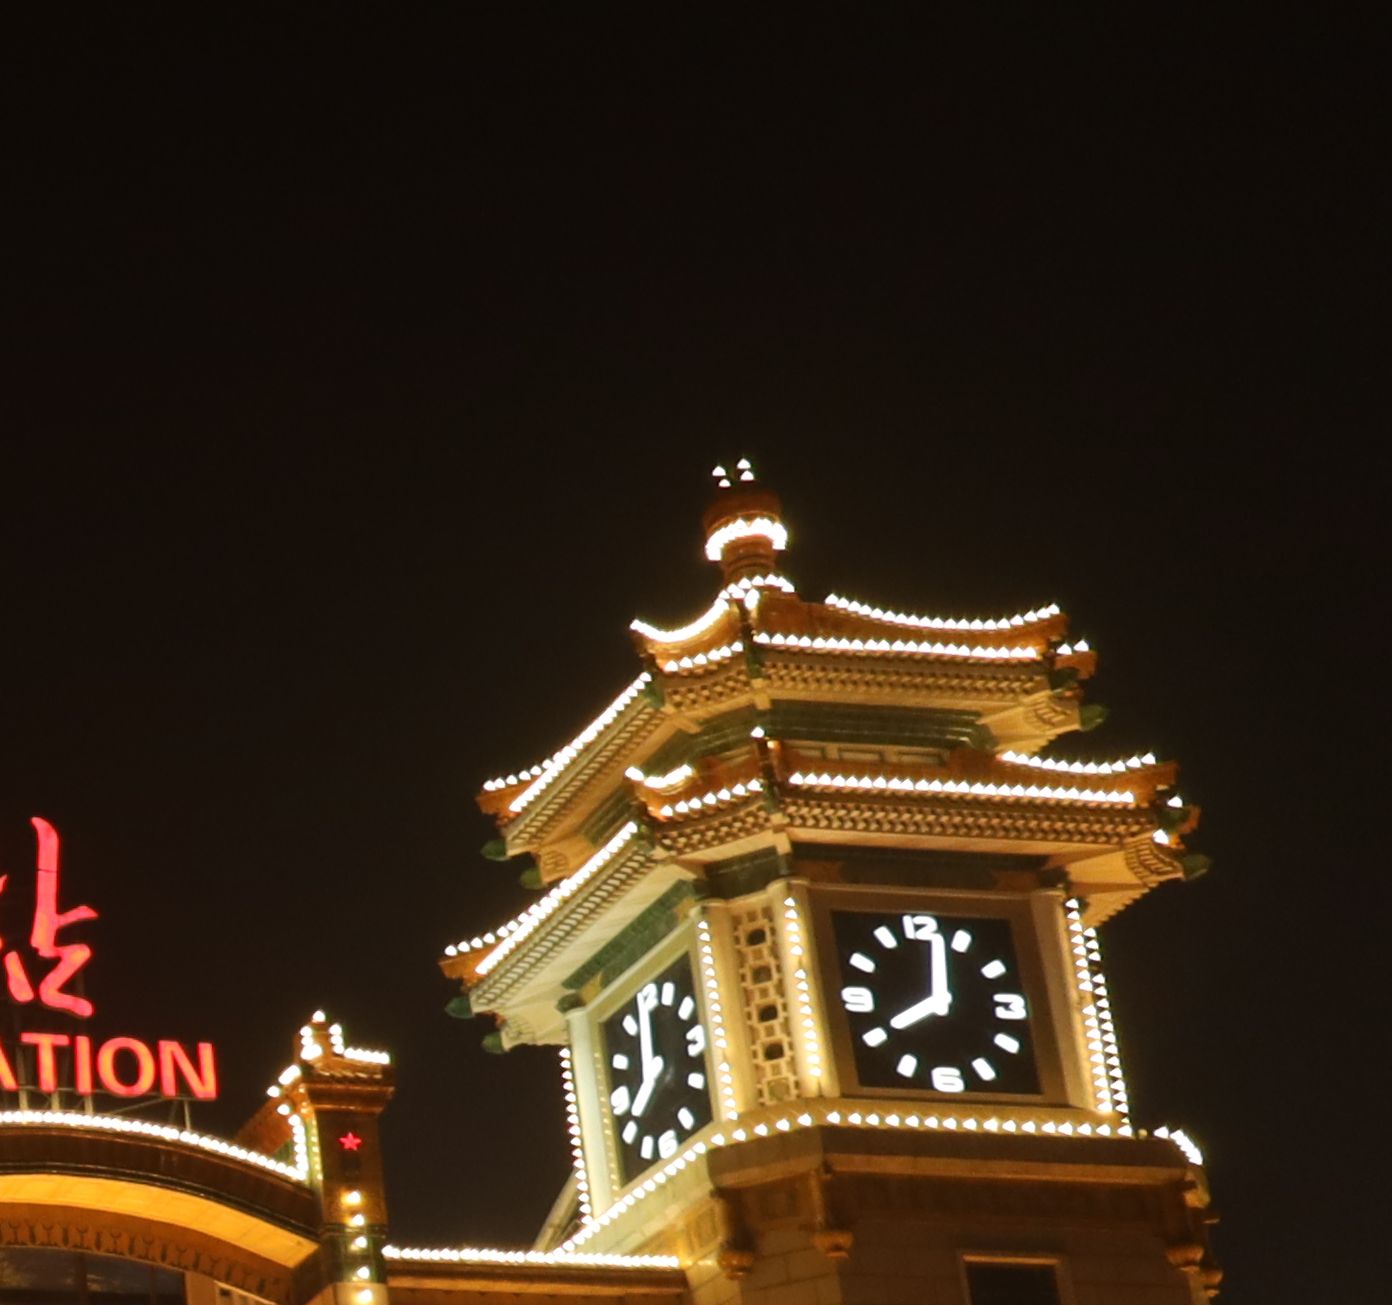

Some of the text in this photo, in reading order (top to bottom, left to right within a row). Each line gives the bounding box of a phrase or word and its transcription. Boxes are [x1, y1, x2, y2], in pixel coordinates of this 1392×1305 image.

[902, 915, 938, 941] 12
[841, 986, 874, 1013] 9
[993, 994, 1026, 1019] 3
[931, 1066, 965, 1093] 6
